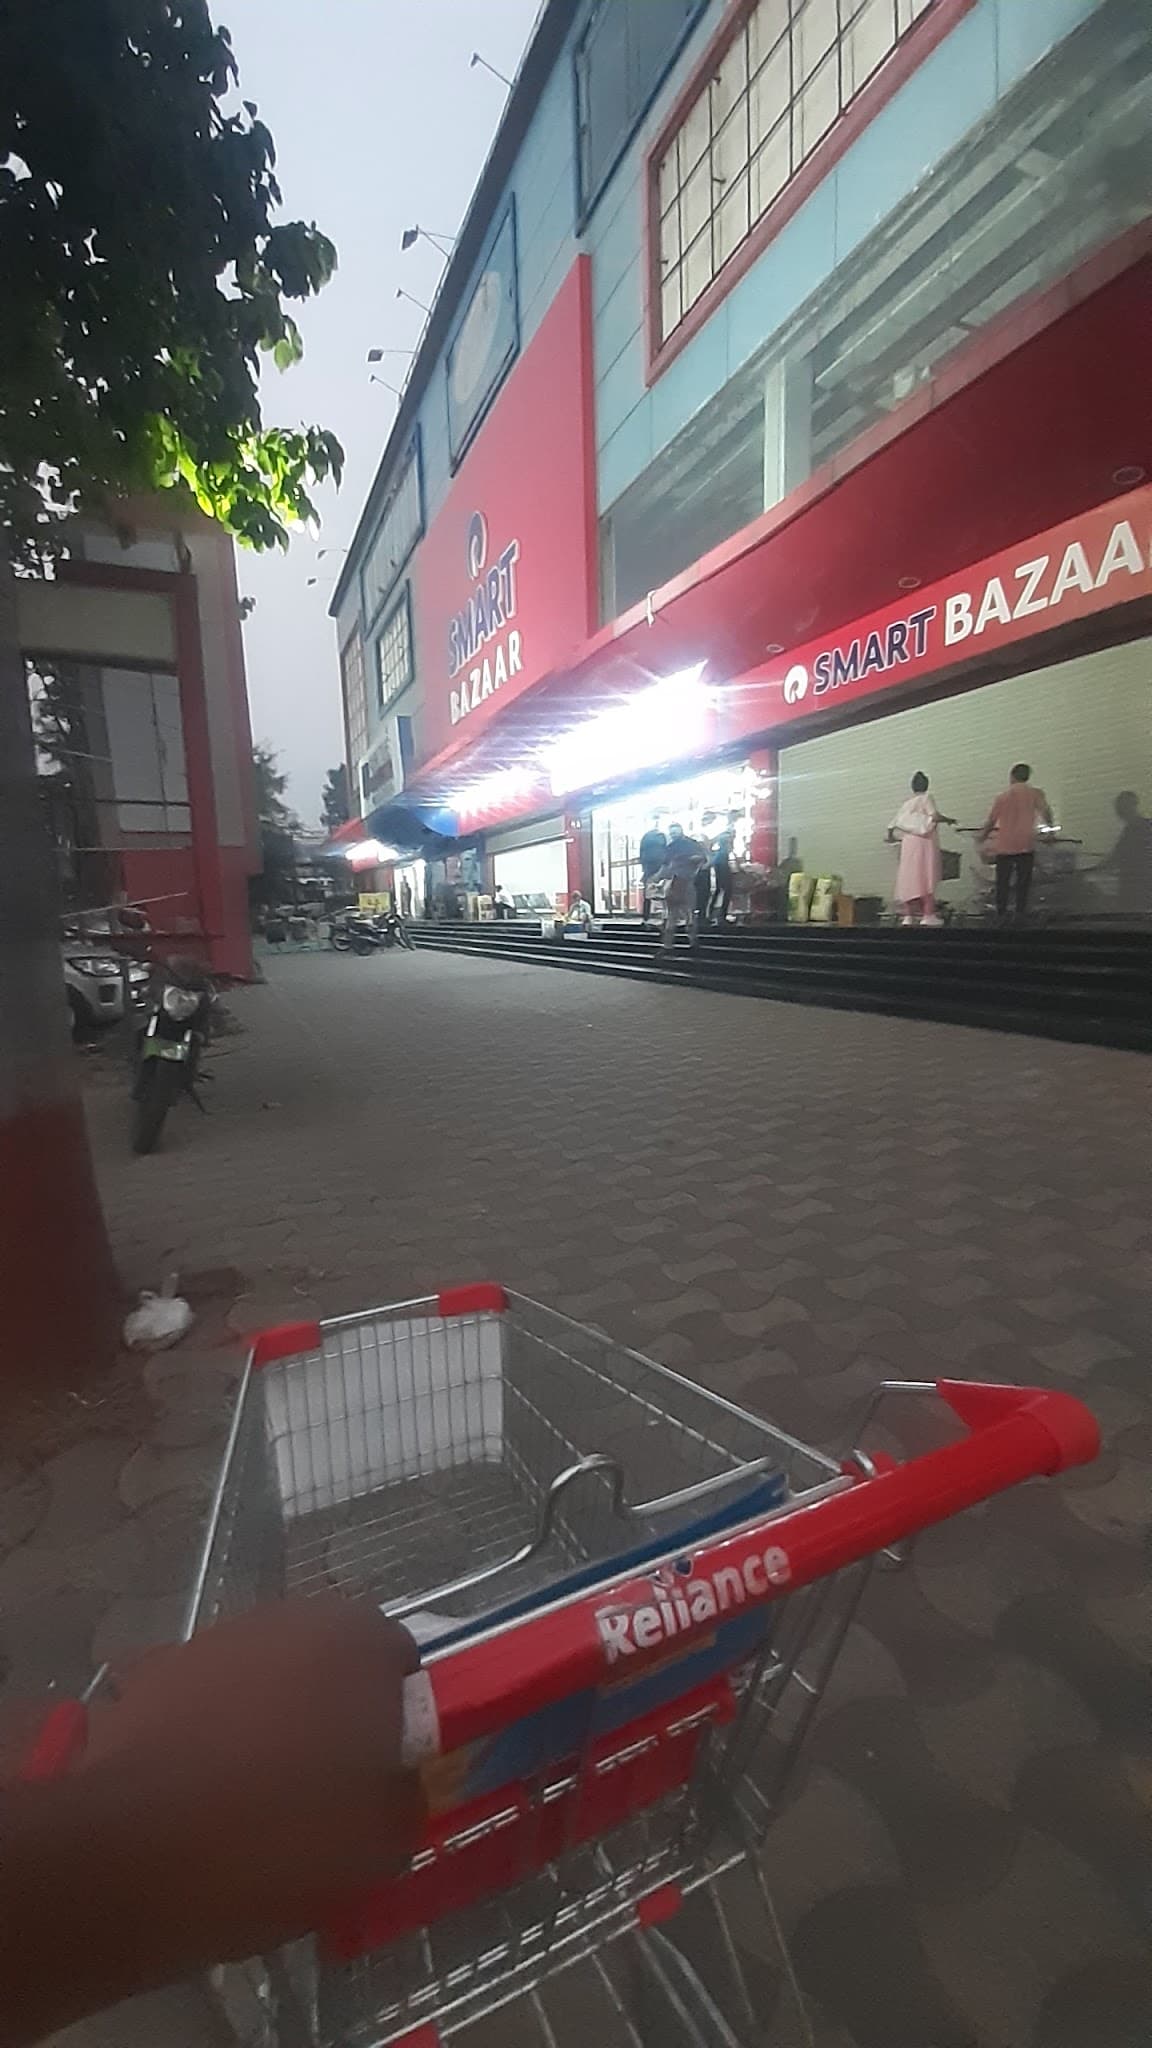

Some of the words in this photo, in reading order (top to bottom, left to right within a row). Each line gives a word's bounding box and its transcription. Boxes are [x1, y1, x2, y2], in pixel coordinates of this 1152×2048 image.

[449, 538, 521, 678] SMART
[812, 605, 937, 696] SMART
[944, 520, 1152, 647] BAZAA
[450, 630, 522, 726] BAZAAR
[594, 1546, 792, 1665] Reliance
